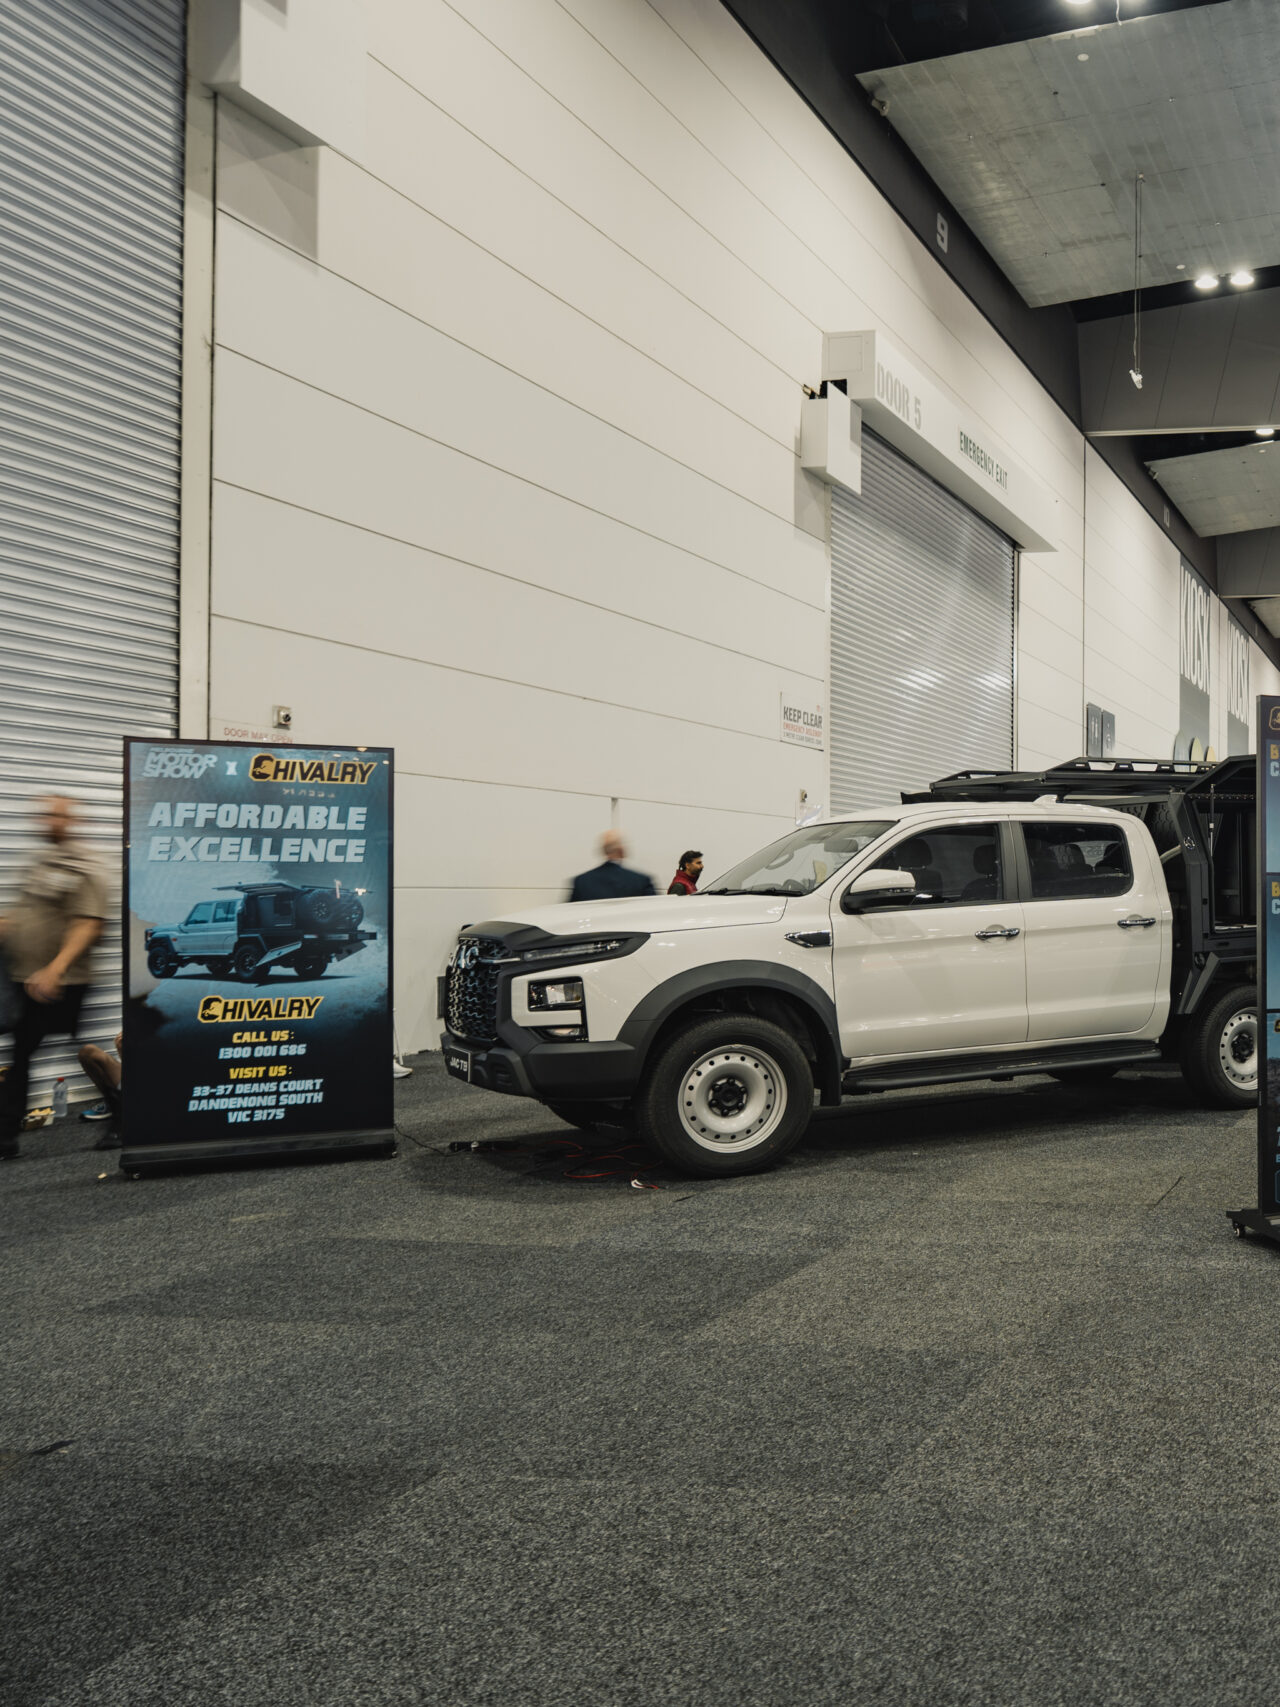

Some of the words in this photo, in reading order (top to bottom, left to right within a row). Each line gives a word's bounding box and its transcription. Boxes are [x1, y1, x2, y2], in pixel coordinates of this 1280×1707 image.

[936, 212, 949, 254] 9
[876, 362, 910, 421] DOOR
[914, 396, 922, 431] 5
[960, 430, 995, 478] EMERGENCY
[995, 463, 1008, 490] EXIT
[1180, 565, 1211, 695] KIOSK
[1229, 620, 1250, 727] KIOSK
[783, 706, 801, 723] KEEP
[803, 711, 823, 729] CLEAR
[223, 727, 249, 738] DOOR
[142, 763, 208, 779] SHOW
[146, 752, 218, 768] MOTOR
[249, 753, 377, 785] CHIVALRY
[148, 801, 368, 831] AFFORDABLE
[148, 836, 367, 863] EXCELLENCE
[197, 995, 325, 1023] CHIVALRY
[232, 1031, 268, 1043] CALL
[218, 1047, 252, 1060] 1300
[253, 1045, 278, 1058] 001
[279, 1043, 307, 1056] 686
[229, 1066, 267, 1080] VISIT
[192, 1084, 233, 1097] 33-37
[235, 1081, 278, 1094] DEANS
[279, 1079, 324, 1092] COURT
[188, 1095, 277, 1112] DANDENONG
[278, 1092, 324, 1106] SOUTH
[227, 1110, 251, 1124] VIC
[253, 1108, 286, 1121] 3175
